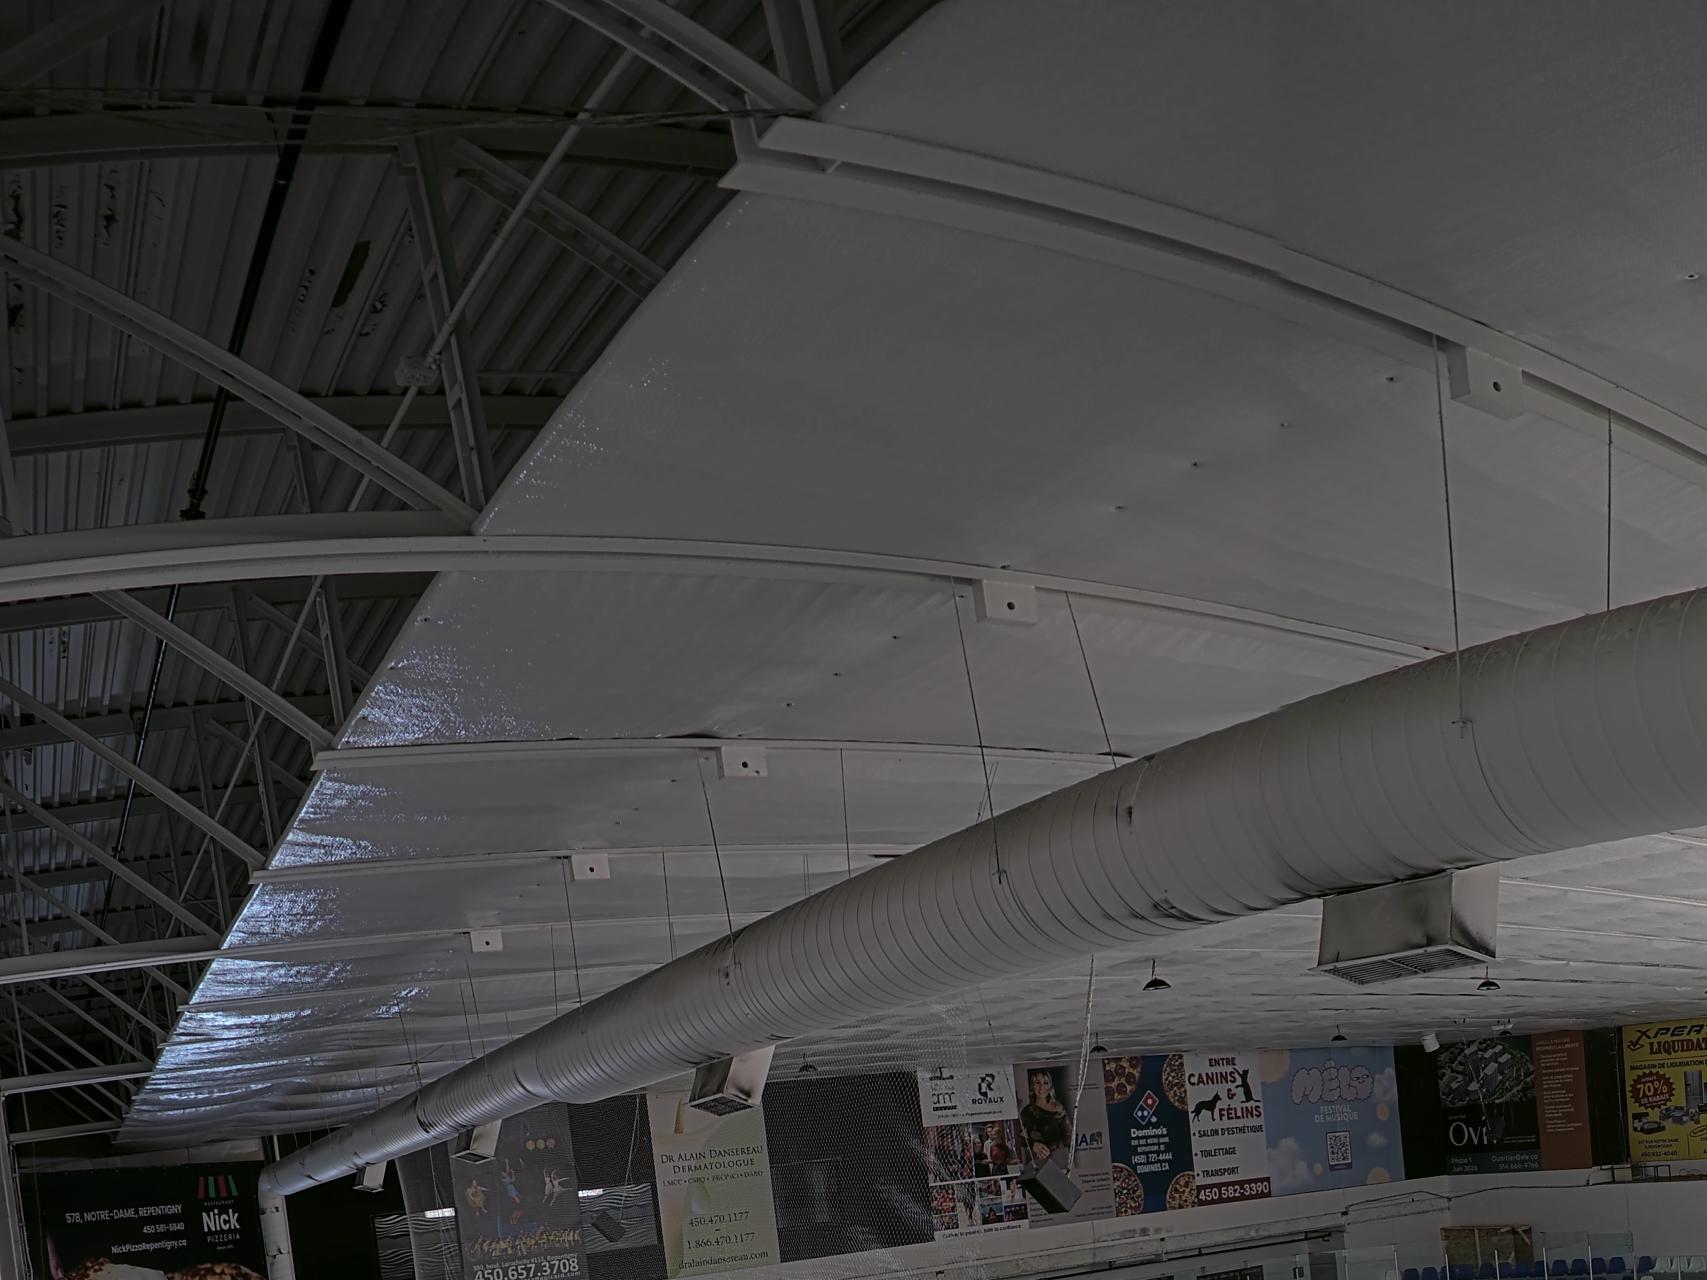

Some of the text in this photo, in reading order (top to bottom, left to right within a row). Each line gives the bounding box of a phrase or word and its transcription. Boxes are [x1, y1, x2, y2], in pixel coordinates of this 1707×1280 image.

[1209, 1057, 1236, 1067] ENTRE
[1630, 1063, 1657, 1071] MAGASIN
[1667, 1059, 1704, 1068] LIQUIDATION
[1188, 1071, 1237, 1086] CANINS
[1227, 1088, 1236, 1100] &
[1637, 1079, 1668, 1098] 70%
[1218, 1104, 1262, 1121] FÉLINS
[1320, 1104, 1352, 1114] FESTIVAL
[1130, 1127, 1168, 1137] Domino's
[1198, 1124, 1264, 1138] SALON D'ESTHÉTIQUE
[678, 1151, 706, 1161] ALAIN
[709, 1145, 763, 1159] DANSEREAU
[1200, 1147, 1237, 1158] TOILETTAGE
[672, 1158, 756, 1174] DERMATOLOGUE
[1201, 1166, 1240, 1178] TRANSPORT
[1199, 1181, 1270, 1201] 450 582-3390
[65, 1204, 182, 1224] 578, NOTRE-DAME, REPENTIGNY
[202, 1209, 241, 1232] Nick
[688, 1211, 750, 1228] 450.470.1177
[207, 1233, 241, 1243] PIZZERIA
[687, 1232, 755, 1249] 1.866.470.1177
